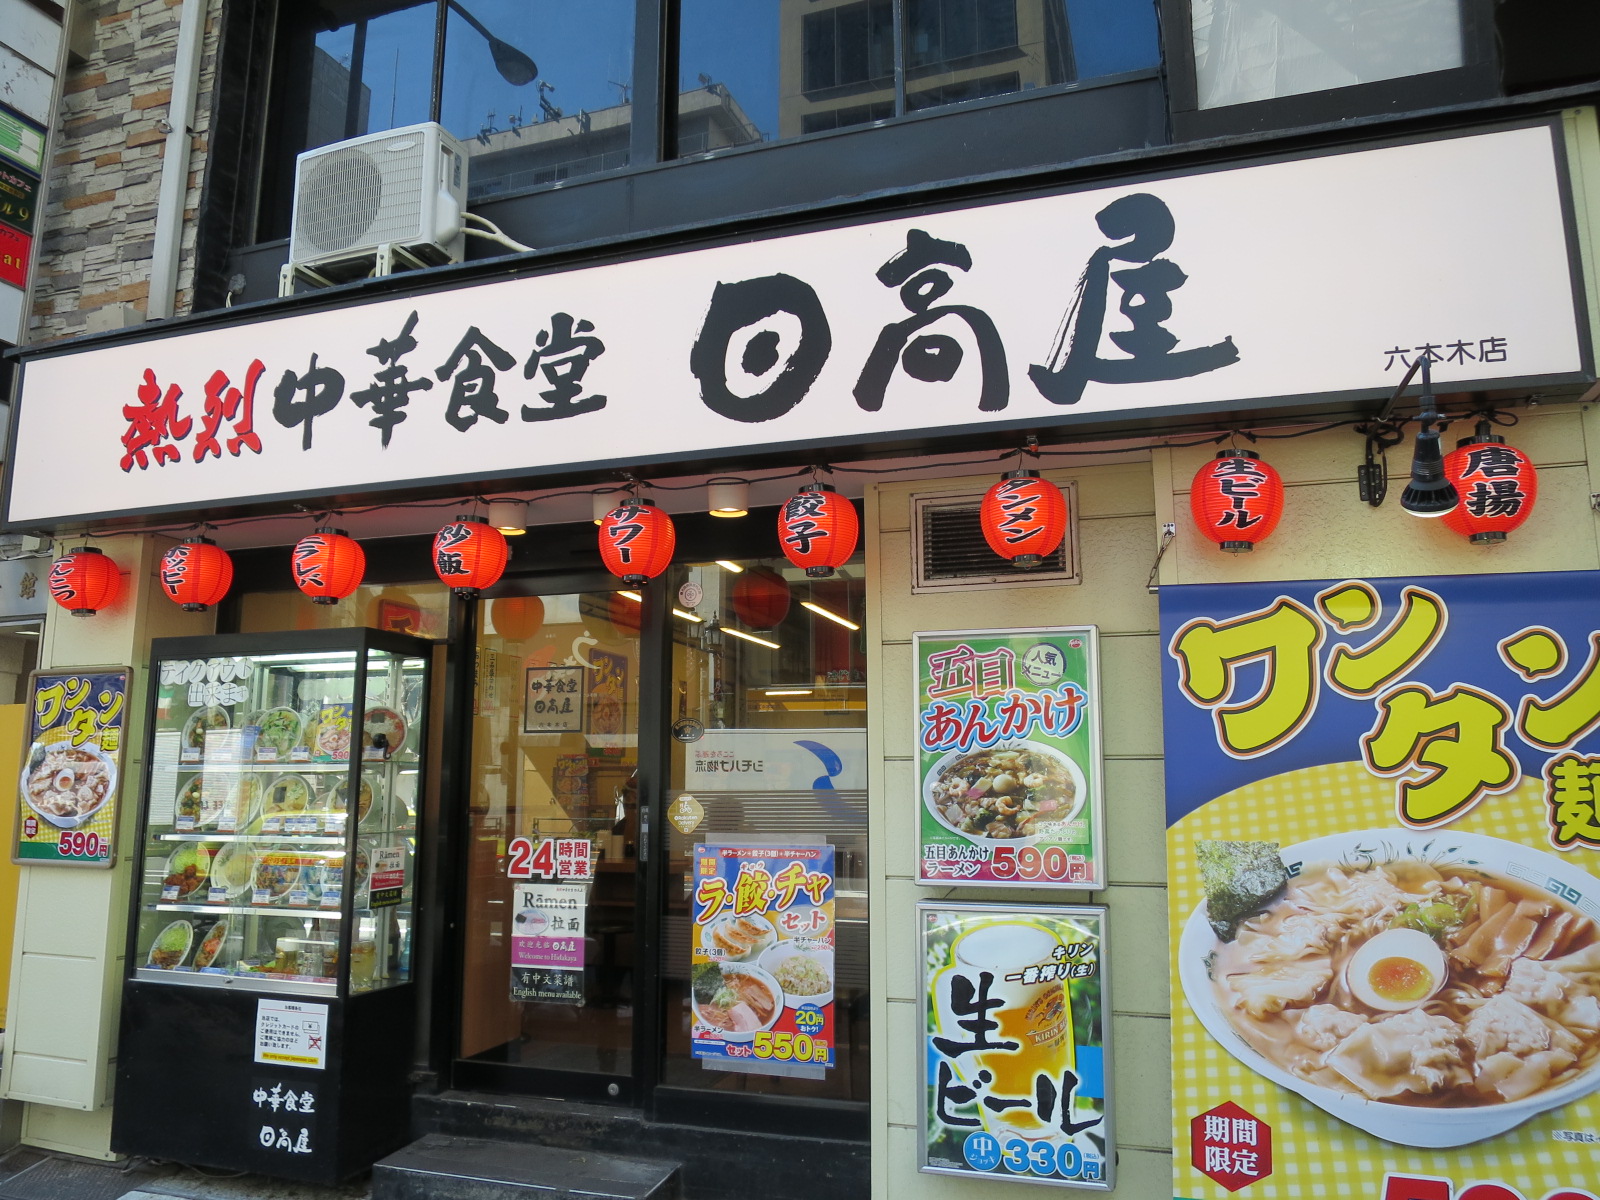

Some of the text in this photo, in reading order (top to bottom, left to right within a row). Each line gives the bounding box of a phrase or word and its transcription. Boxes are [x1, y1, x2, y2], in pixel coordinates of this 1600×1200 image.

[690, 193, 1240, 423] 日高屋
[1384, 337, 1508, 371] 六本木店
[1211, 457, 1267, 529] 生ビール
[1461, 446, 1526, 518] 唐揚
[783, 491, 829, 555] 餃子
[997, 477, 1044, 546] タンメン
[606, 502, 652, 565] サワー
[433, 522, 473, 577] 炒飯
[294, 536, 326, 588] ニラレバ
[1031, 650, 1057, 667] 人気
[161, 658, 252, 683] テイクアウト
[928, 644, 1015, 699] 五目
[1021, 664, 1062, 681] メニュー
[189, 683, 248, 704] 出来ます
[532, 676, 578, 693] 中華食堂
[534, 697, 573, 714] 日高屋
[923, 686, 1084, 748] あんかけ
[925, 845, 989, 861] 五目あんかけ
[926, 862, 980, 877] ラーメン
[522, 892, 578, 909] Rāmen
[551, 916, 579, 932] 拉面
[782, 910, 826, 932] セット
[519, 952, 544, 960] Welcome
[1052, 943, 1094, 960] キリン
[513, 987, 581, 999] English menu available
[1035, 1028, 1059, 1042] KIRIN
[726, 1045, 752, 1057] セット
[253, 1082, 315, 1113] 中華食堂
[937, 1061, 1103, 1135] ビール
[260, 1125, 312, 1153] 日高屋
